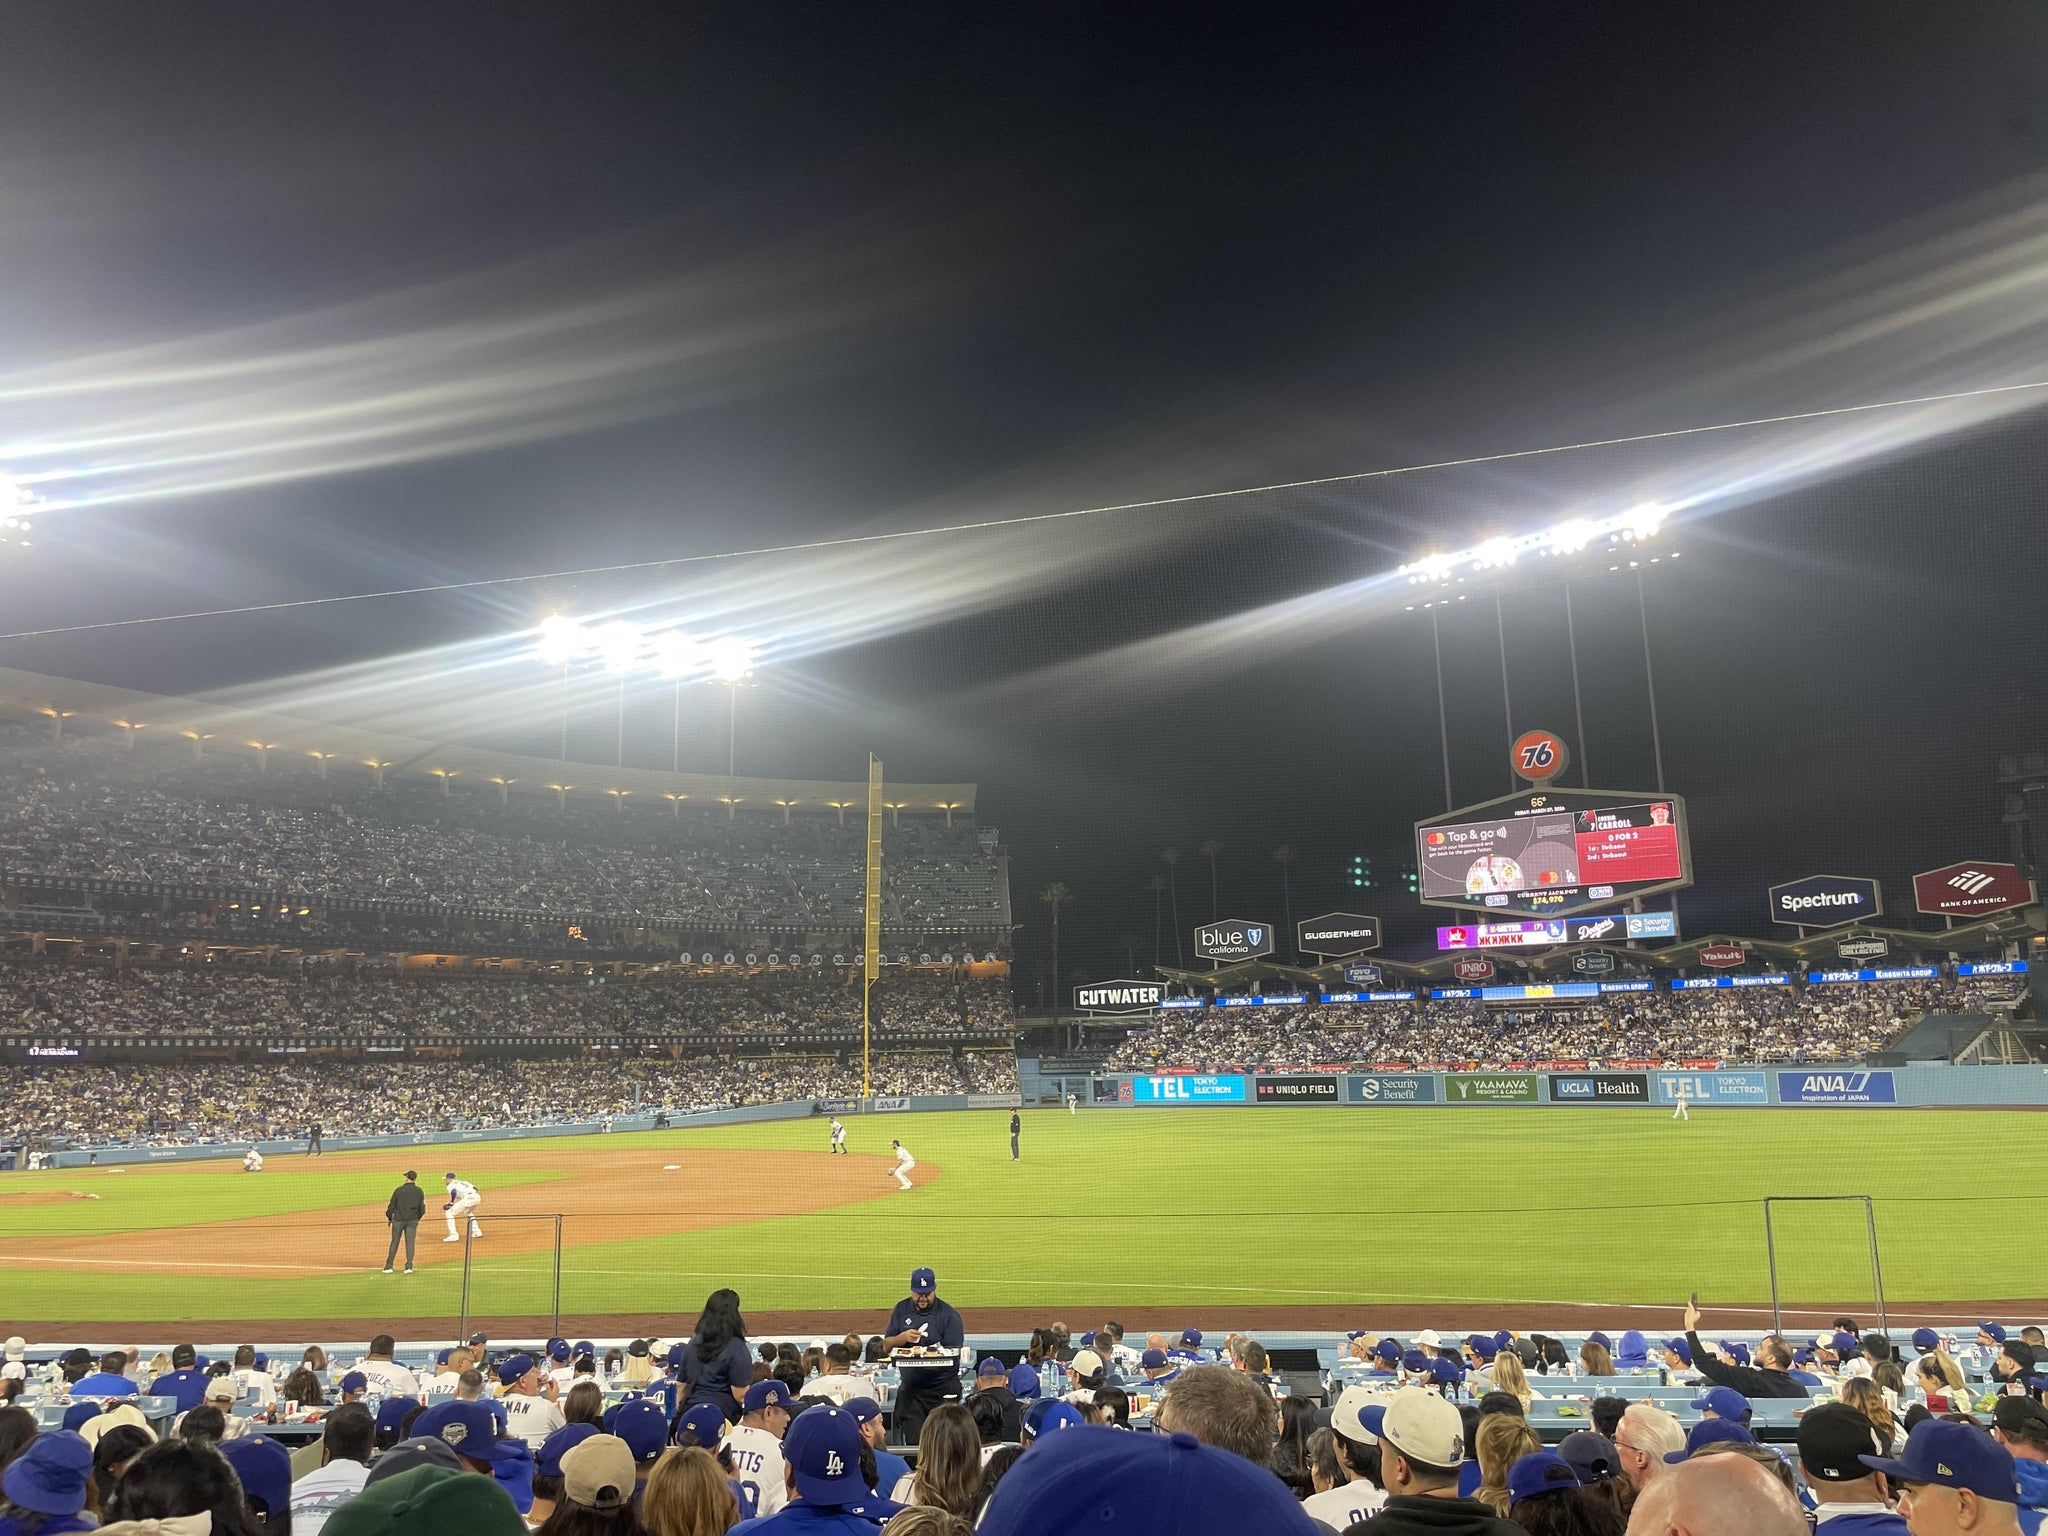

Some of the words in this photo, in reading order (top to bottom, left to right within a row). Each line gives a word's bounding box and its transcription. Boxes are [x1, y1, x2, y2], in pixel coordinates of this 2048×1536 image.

[1521, 741, 1553, 768] 76
[1598, 819, 1632, 830] CARROLL
[1447, 832, 1468, 842] Tap
[1470, 830, 1478, 840] &
[1480, 830, 1494, 841] go
[1566, 870, 1576, 882] LA
[1781, 891, 1859, 912] Spectrum
[1940, 900, 1960, 908] BANK
[1644, 917, 1670, 926] Security
[1578, 918, 1614, 940] Dodgers
[1202, 929, 1242, 946] blue
[1209, 946, 1248, 954] california
[1702, 952, 1742, 960] Yakult
[1461, 963, 1486, 975] JINRO
[1876, 970, 1910, 978] KINOSHITA
[1080, 988, 1159, 1005] CUTWATER
[1382, 1079, 1419, 1090] Security
[1718, 1077, 1746, 1085] TOKYO
[1802, 1076, 1845, 1091] ANA
[1120, 1088, 1131, 1096] 76
[1149, 1078, 1189, 1098] TEL
[1194, 1086, 1231, 1094] ELECTRON
[1276, 1085, 1306, 1094] UNIQLO
[1309, 1085, 1335, 1094] FIELD
[1562, 1083, 1589, 1093] UCLA
[1598, 1082, 1640, 1094] Health
[1662, 1078, 1710, 1098] TEL
[1719, 1086, 1764, 1094] ELECTRON
[1384, 1089, 1415, 1099] Benefit
[1802, 1094, 1836, 1102] Inspiration
[877, 1101, 896, 1109] ANA
[826, 1450, 844, 1475] LA
